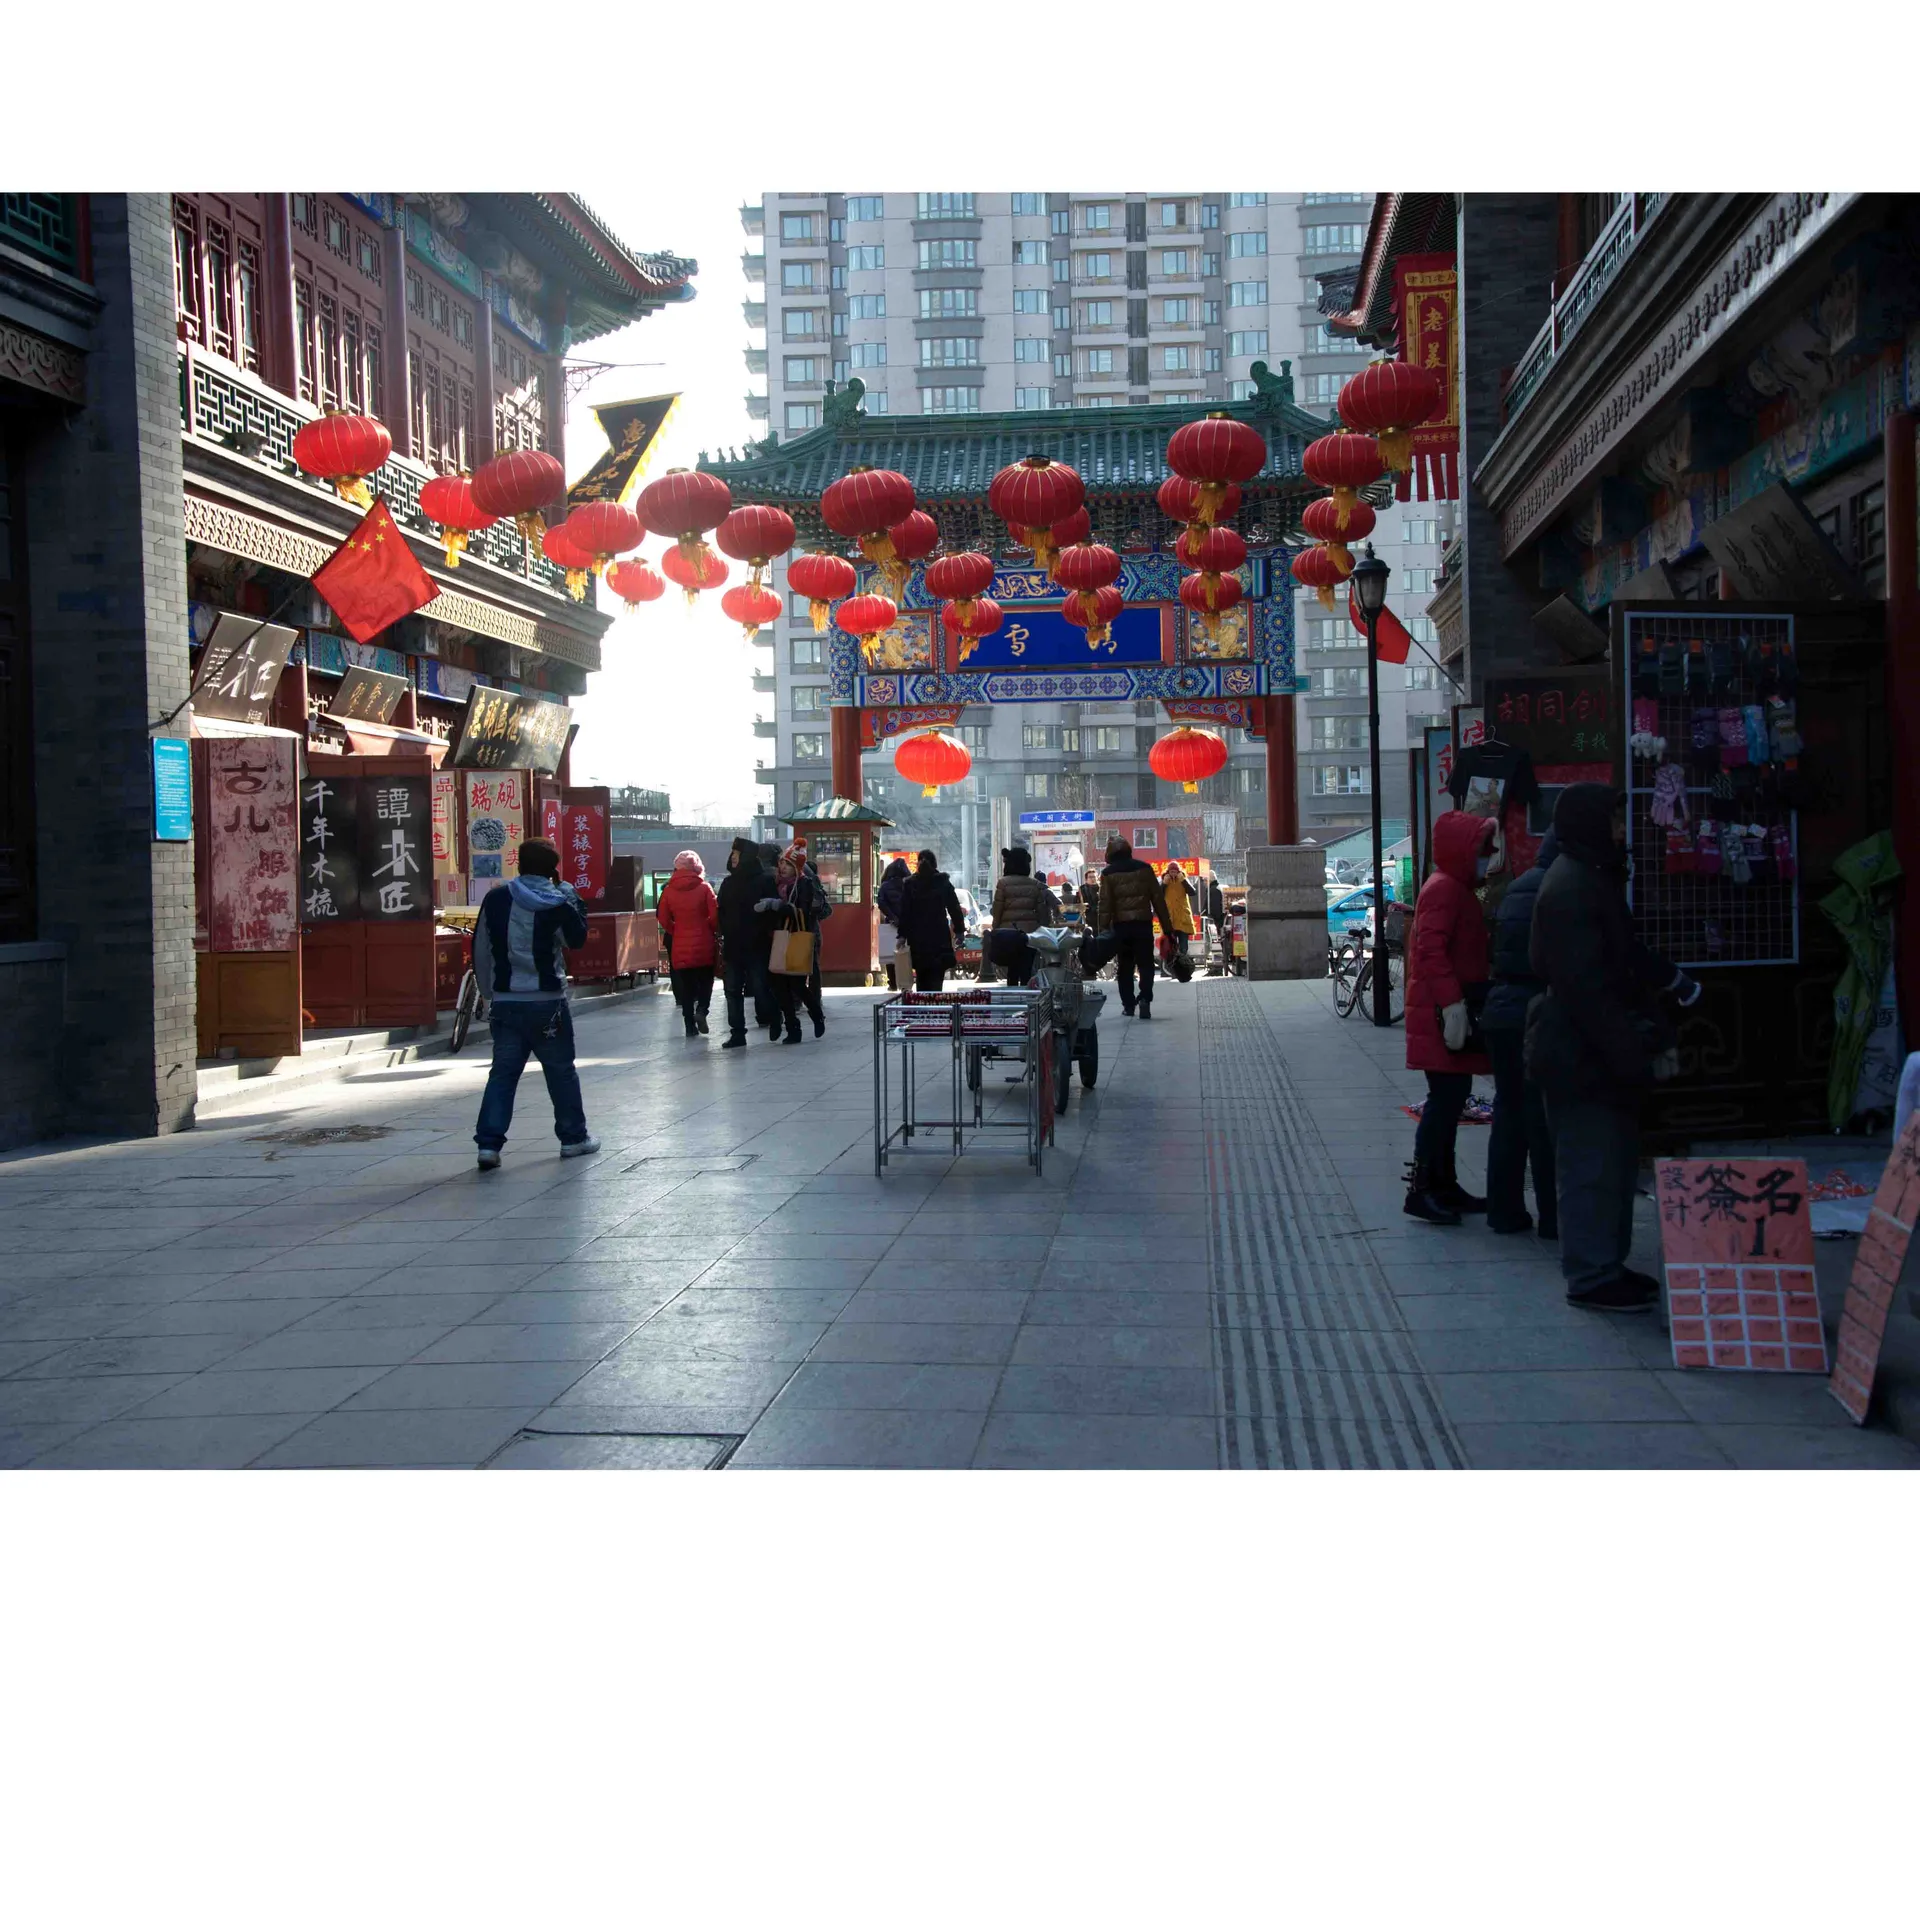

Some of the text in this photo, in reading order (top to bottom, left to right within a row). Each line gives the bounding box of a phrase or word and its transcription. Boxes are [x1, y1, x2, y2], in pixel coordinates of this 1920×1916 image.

[1422, 307, 1446, 396] 老美
[1498, 689, 1622, 726] 胡同创
[471, 778, 521, 812] 端砚
[305, 780, 338, 917] 千年木梳
[372, 788, 419, 913] 譚木匠
[505, 823, 522, 866] 专卖
[572, 815, 592, 890] 装裱字画
